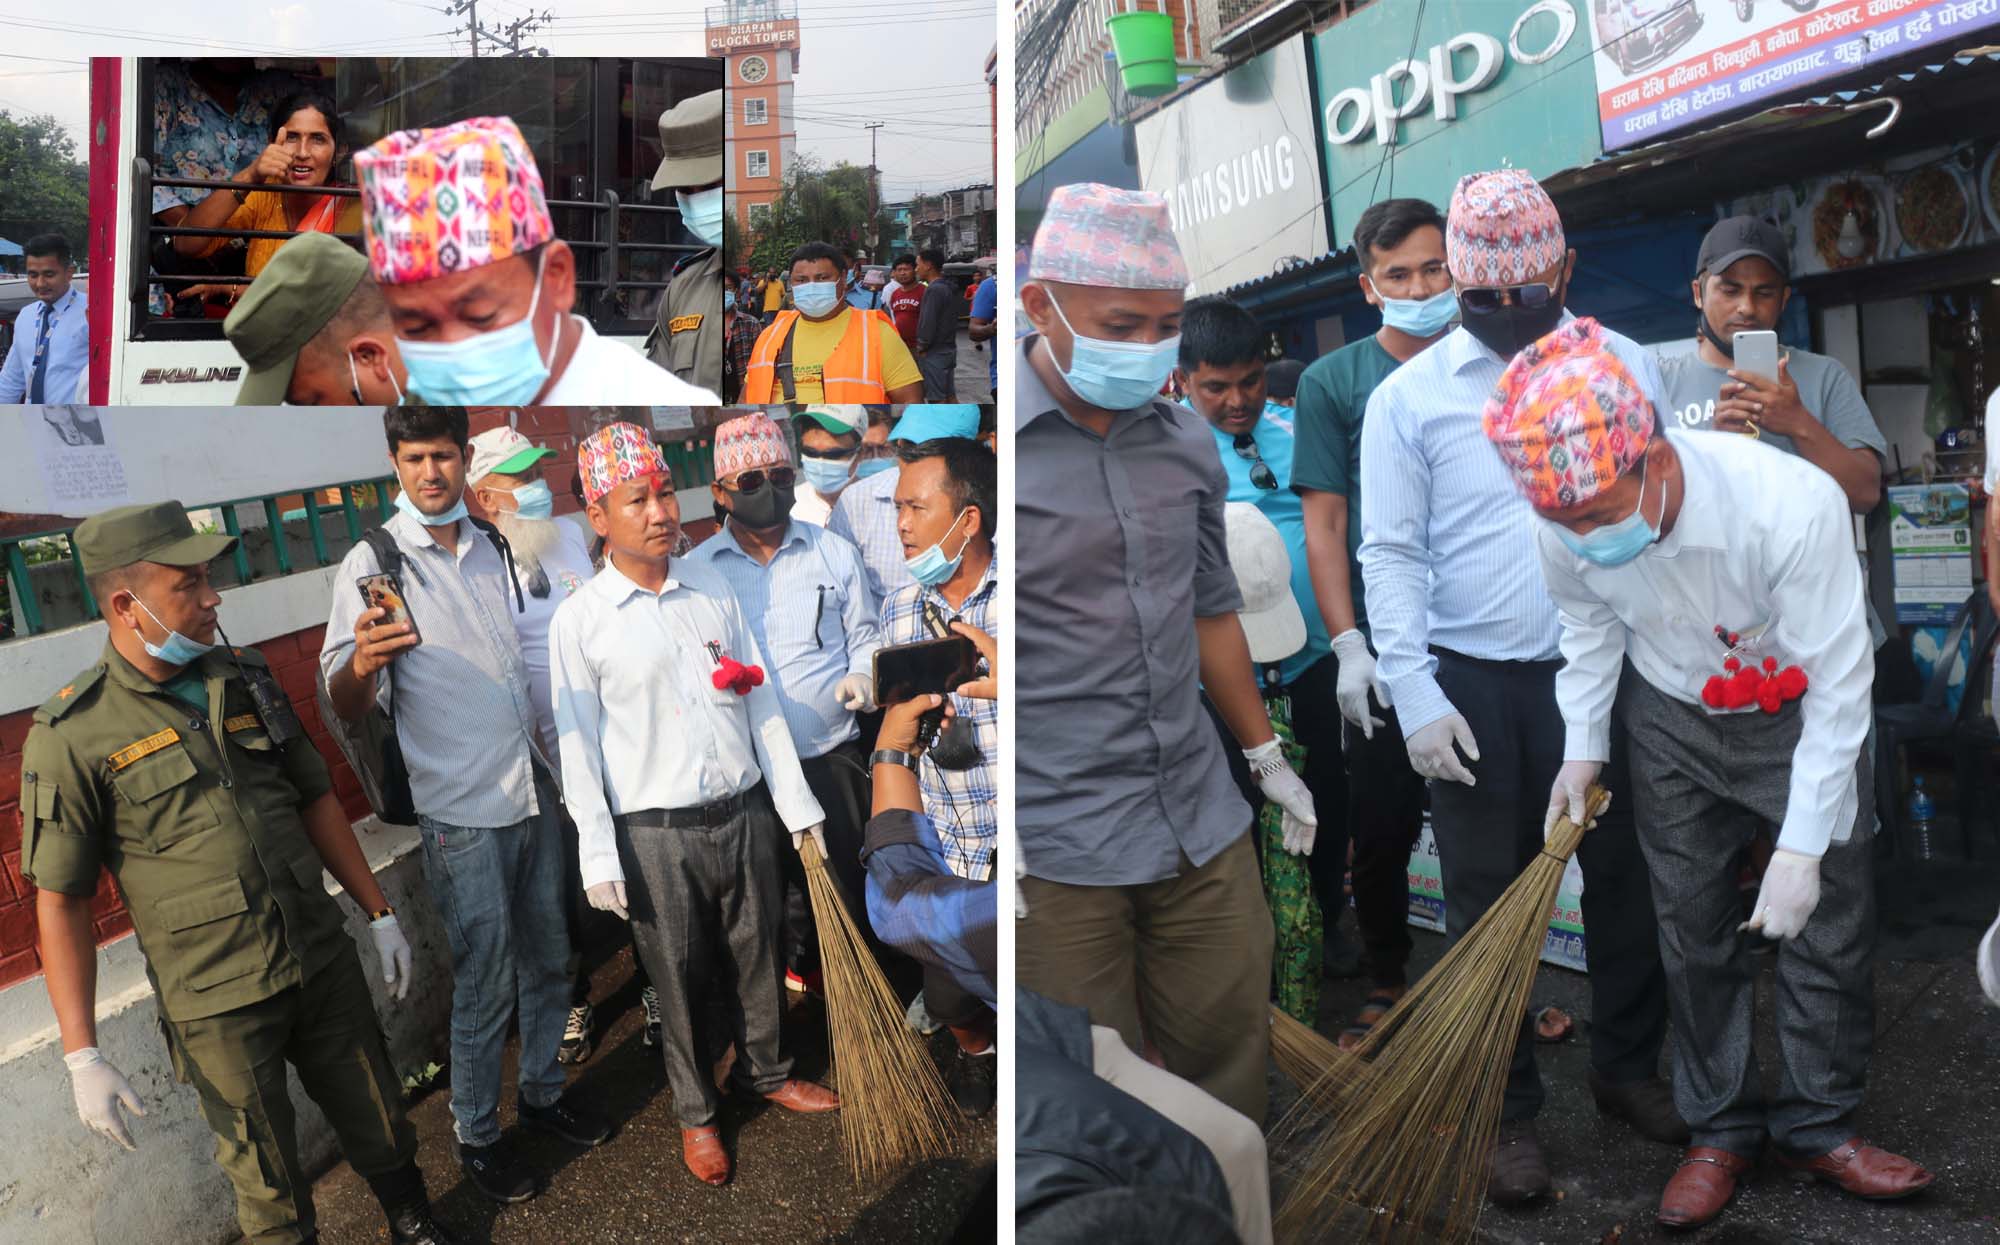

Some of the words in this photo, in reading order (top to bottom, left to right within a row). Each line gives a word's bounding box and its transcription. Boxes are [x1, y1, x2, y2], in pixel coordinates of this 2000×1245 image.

[730, 22, 774, 35] DHARAN
[711, 34, 750, 48] CLOCK
[754, 30, 796, 43] TOWER
[140, 367, 242, 385] SKYLINE
